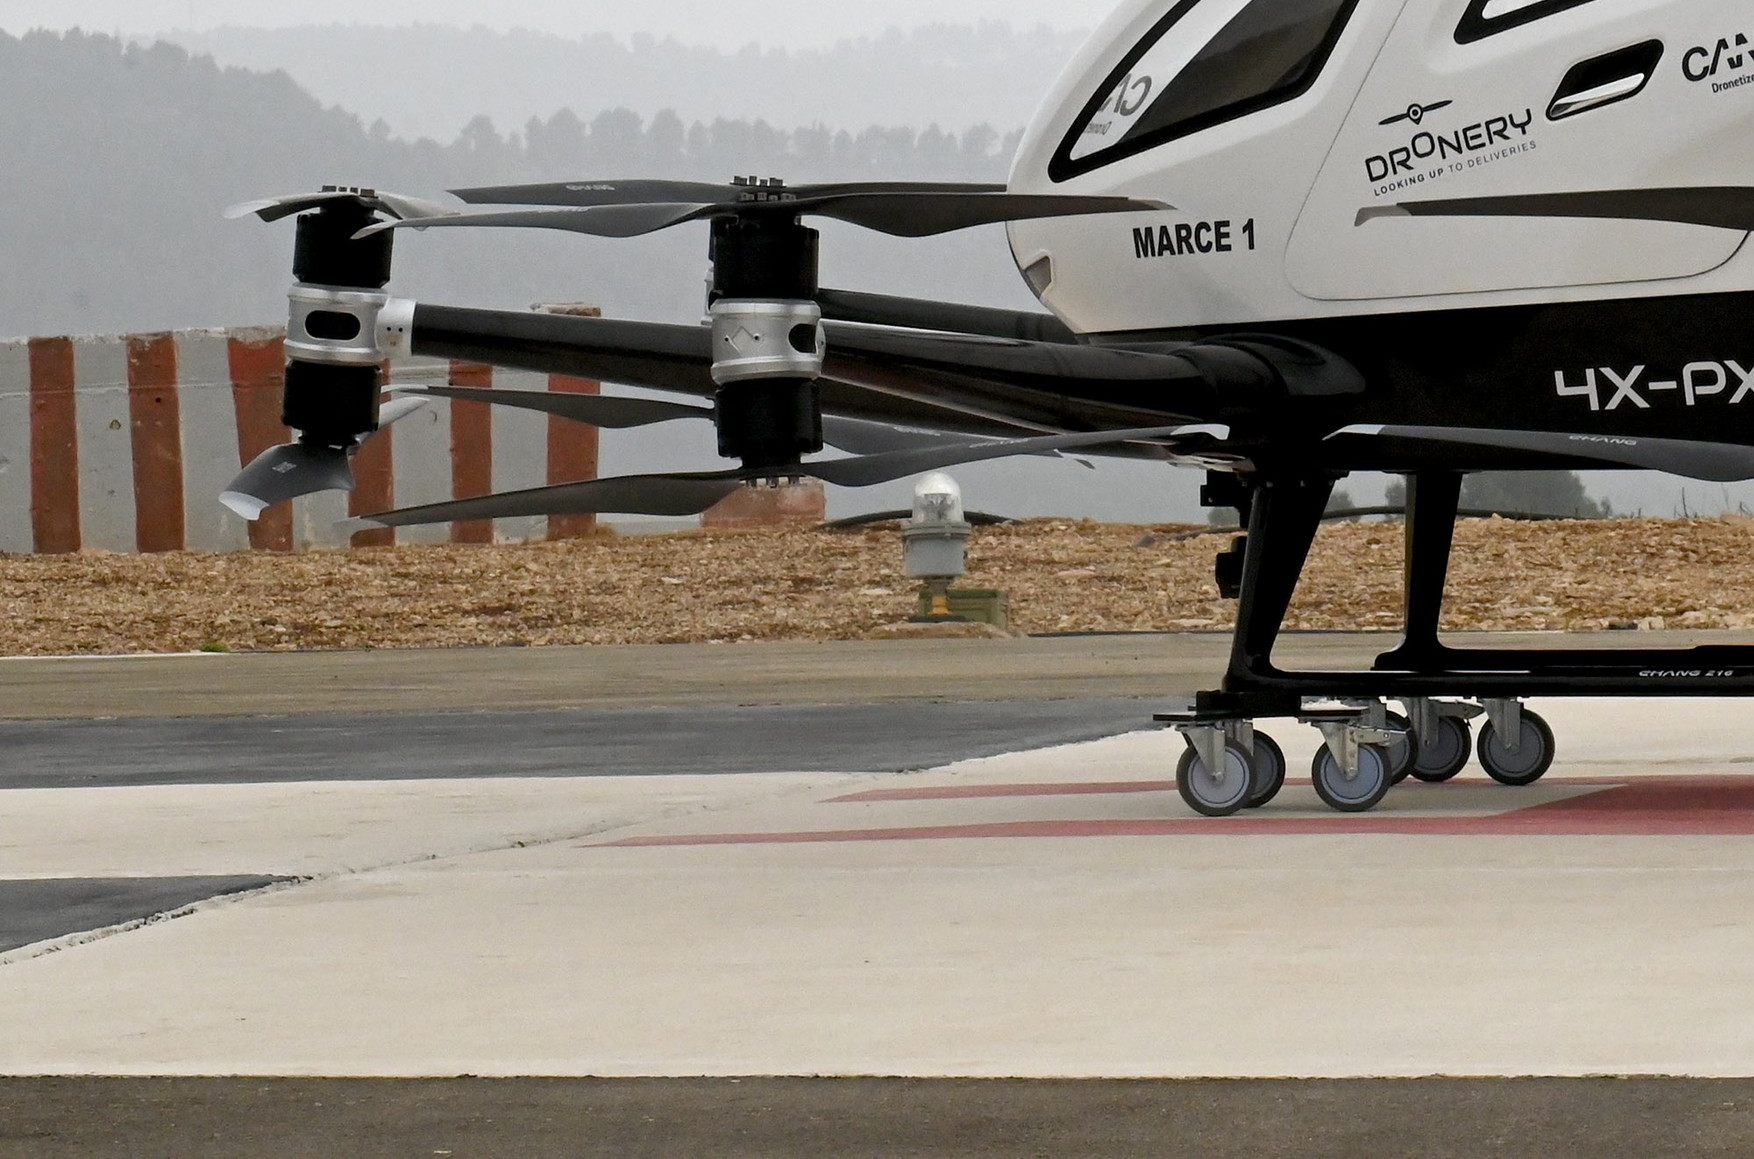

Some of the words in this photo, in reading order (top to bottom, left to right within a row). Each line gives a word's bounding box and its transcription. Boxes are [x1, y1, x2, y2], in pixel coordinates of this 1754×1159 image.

[1365, 108, 1533, 182] DRONERY
[1373, 173, 1425, 196] LOOKING
[1429, 168, 1444, 179] UP
[1448, 163, 1463, 173] TO
[1467, 140, 1537, 168] DELIVERIES
[1132, 220, 1232, 258] MARCE
[1242, 218, 1255, 250] 1
